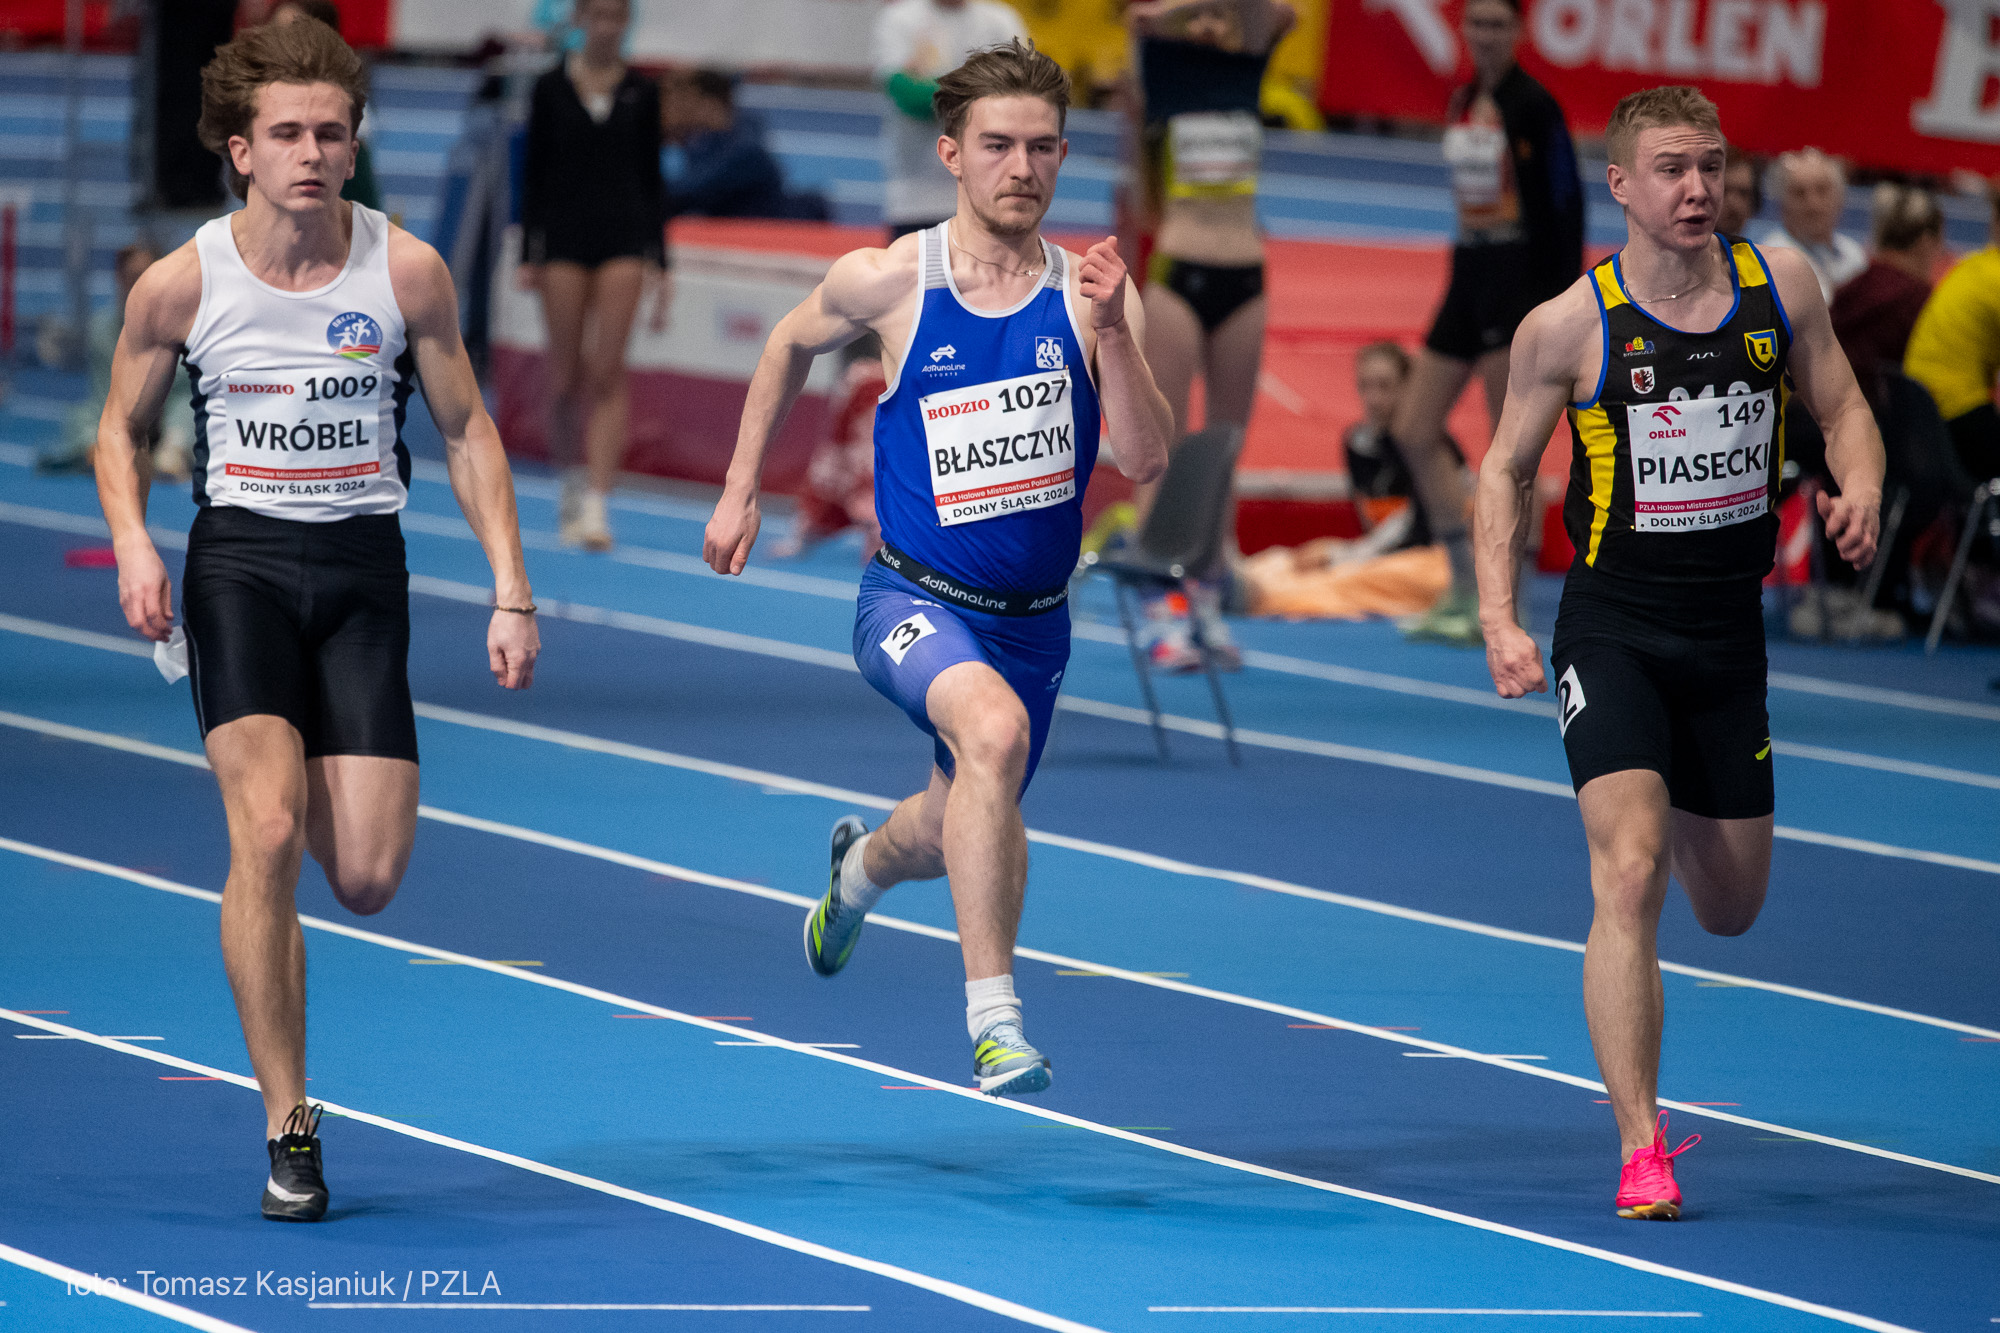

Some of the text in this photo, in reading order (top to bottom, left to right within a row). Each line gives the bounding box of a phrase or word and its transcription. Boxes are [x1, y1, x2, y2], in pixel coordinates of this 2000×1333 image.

[1530, 0, 1827, 88] ORLEN
[228, 375, 377, 402] BODZIO 1009
[926, 378, 1067, 420] BODZIO 1027
[1717, 398, 1765, 428] 149
[236, 418, 369, 451] WRÓBEL
[1649, 428, 1686, 439] ORLEN
[935, 423, 1072, 476] BŁASZCZYK
[1637, 442, 1768, 484] PIASECKI
[240, 480, 365, 496] DOLNY ŚLĄSK 2024
[276, 470, 322, 479] Mistrzostwa
[323, 468, 345, 478] Polski
[939, 496, 957, 504] PZLA
[957, 491, 986, 501] Halowe
[986, 483, 1030, 496] Mistrzostwa
[1030, 477, 1050, 487] Polski
[953, 486, 1069, 518] DOLNY ŚLĄSK 2024
[1657, 503, 1685, 511] Halowe
[1686, 499, 1728, 510] Mistrzostwa
[1729, 494, 1746, 503] Polski
[1650, 502, 1760, 527] DOLNY ŚLĄSK 2024
[918, 575, 1007, 610] AdRunaLine
[893, 622, 920, 651] 3
[1559, 680, 1577, 727] 2
